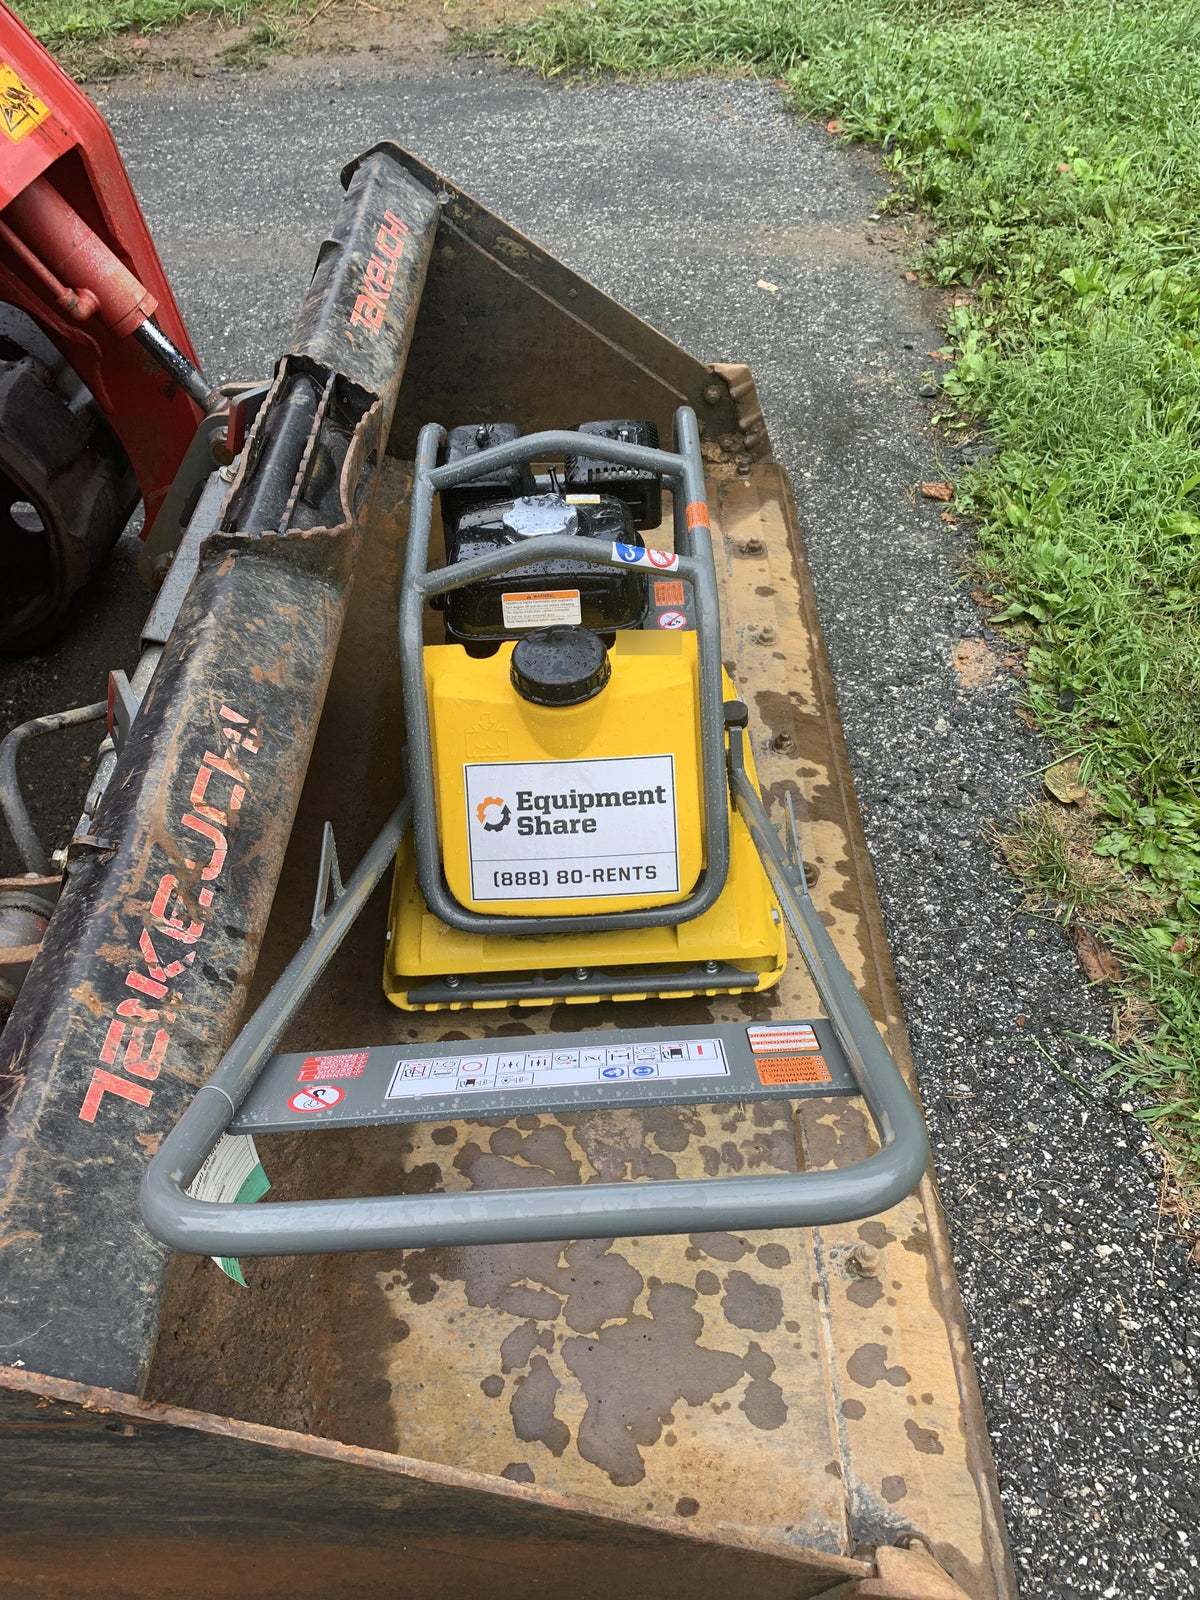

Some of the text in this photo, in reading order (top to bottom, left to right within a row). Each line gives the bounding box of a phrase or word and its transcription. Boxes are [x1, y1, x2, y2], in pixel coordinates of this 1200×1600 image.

[516, 786, 666, 814] Equipment
[517, 816, 597, 836] Share
[494, 865, 657, 887] (888) 80-RENTS
